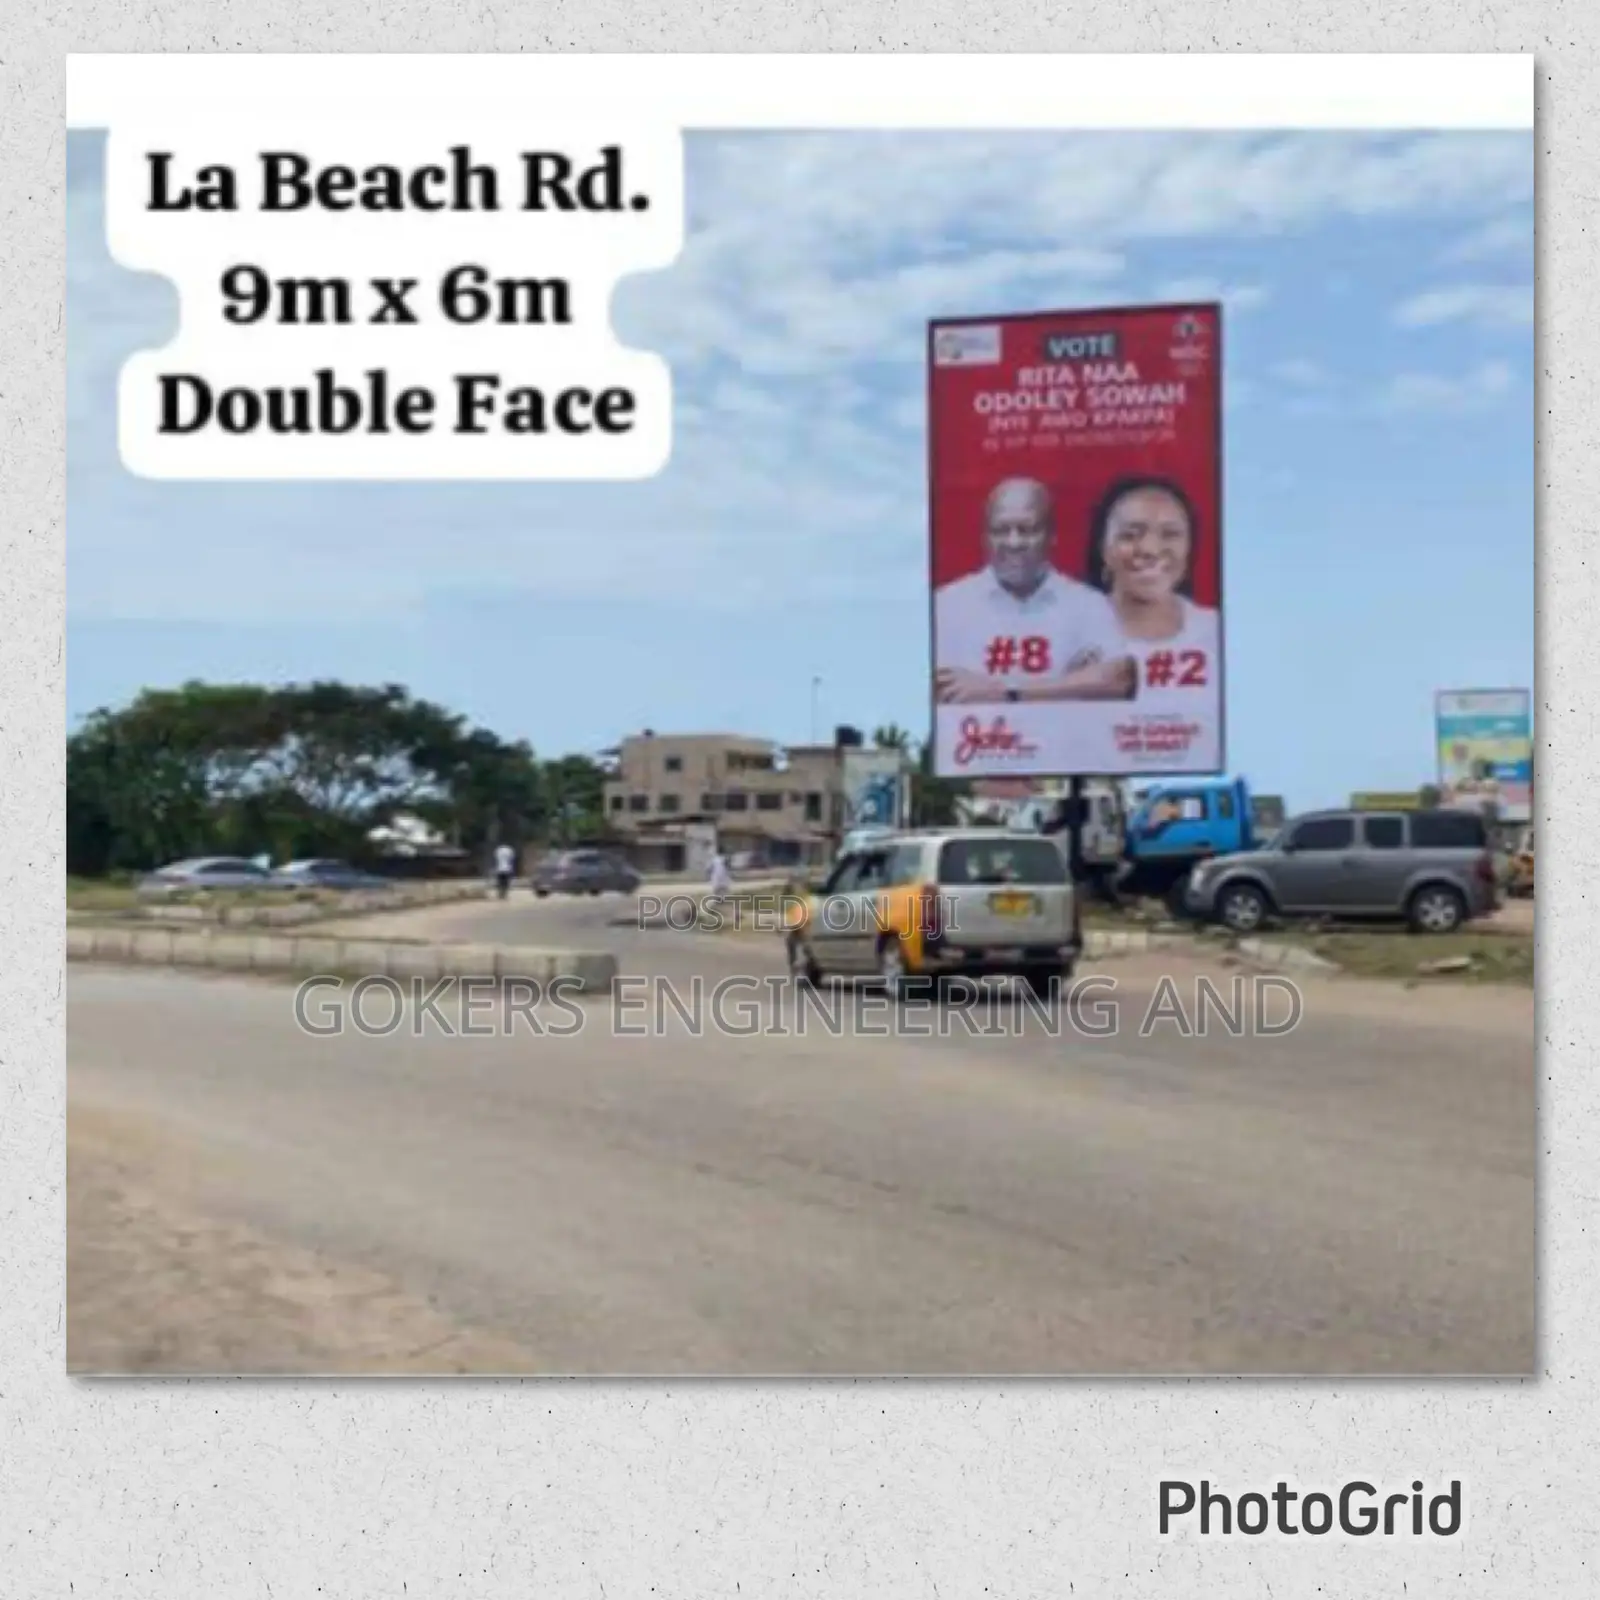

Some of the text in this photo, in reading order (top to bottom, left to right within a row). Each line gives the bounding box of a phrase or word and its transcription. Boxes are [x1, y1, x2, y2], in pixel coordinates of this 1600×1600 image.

[1048, 334, 1116, 358] VOTE
[1018, 363, 1140, 387] RITA NAA
[974, 383, 1187, 414] ODOLEY SOWAH
[985, 635, 1051, 675] #8
[1145, 648, 1208, 687] #2
